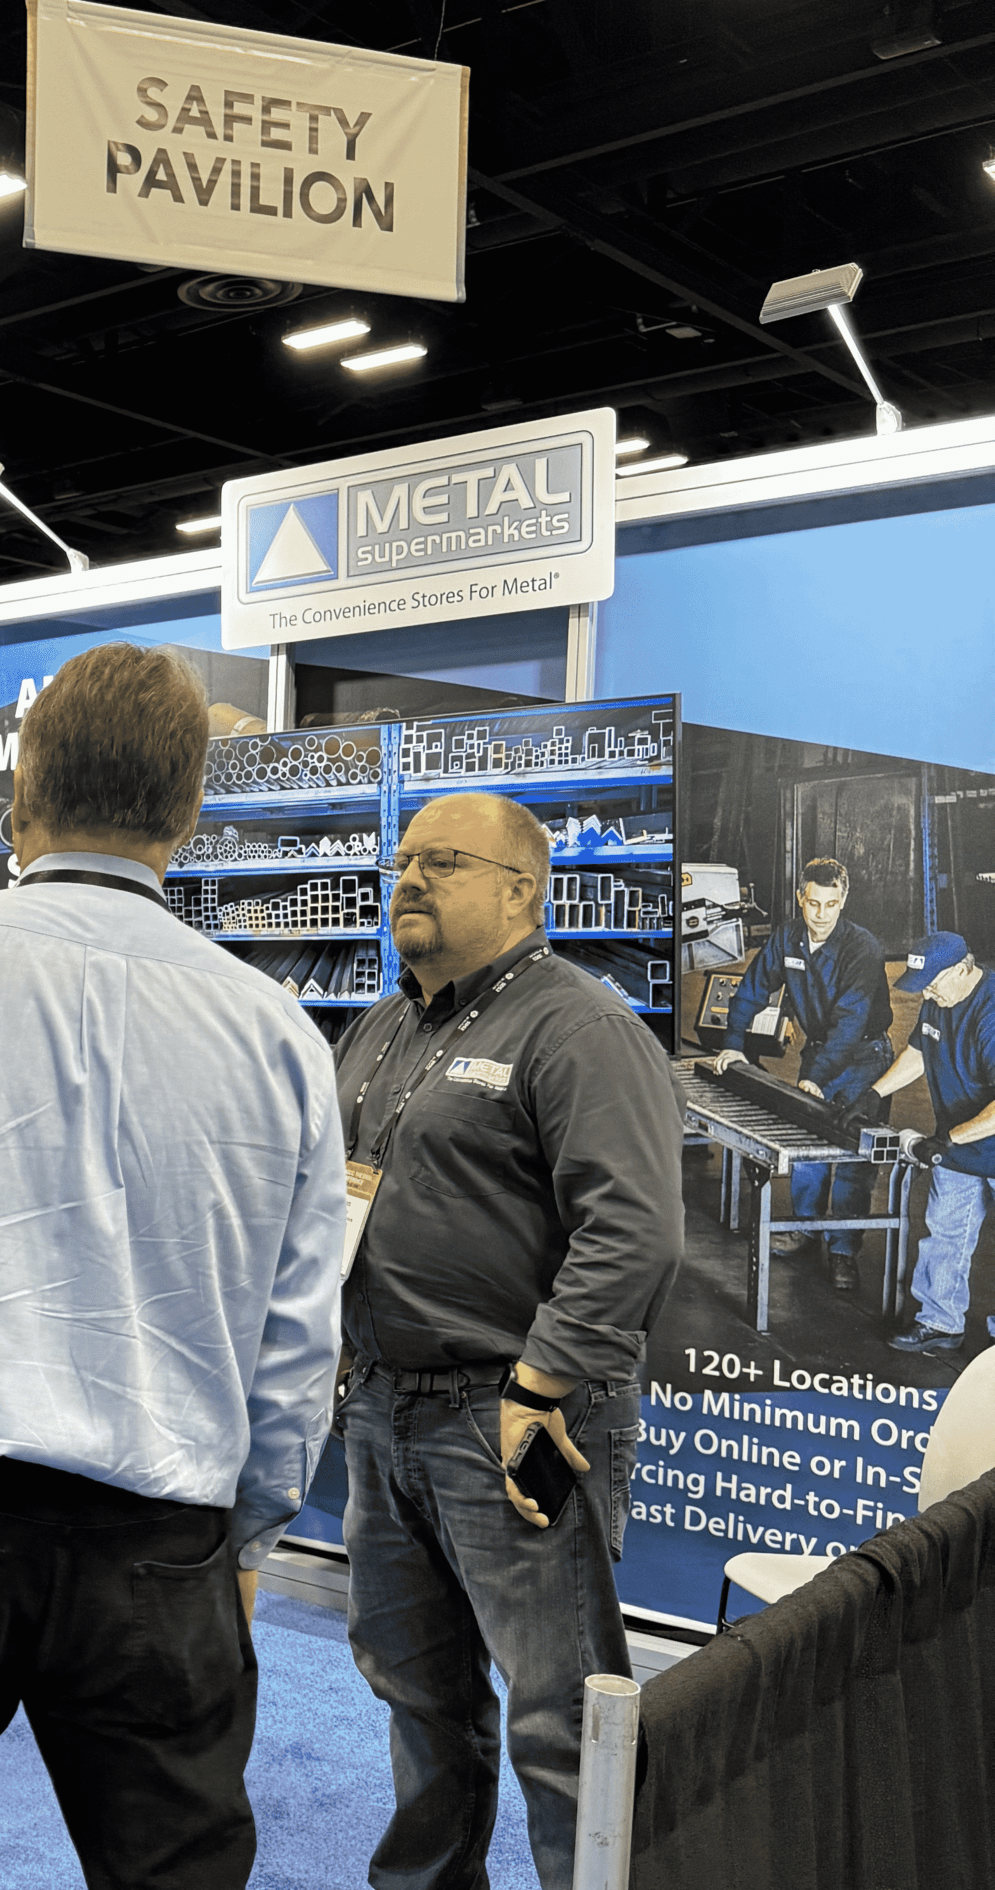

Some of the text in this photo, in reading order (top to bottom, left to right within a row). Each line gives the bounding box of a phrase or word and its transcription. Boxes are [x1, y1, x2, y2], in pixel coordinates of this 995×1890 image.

[135, 76, 372, 161] SAFETY
[106, 140, 395, 232] PAVILION
[356, 457, 571, 538] METAL
[356, 510, 570, 568] supermarkets
[269, 613, 298, 629] The
[302, 597, 406, 624] Convenience
[411, 591, 464, 609] Stores
[469, 582, 497, 601] For
[471, 1061, 509, 1077] METAL
[684, 1348, 939, 1412] 120+ Locations
[650, 1381, 693, 1411] No
[702, 1389, 861, 1441] Minimum
[630, 1460, 705, 1499] rcing
[636, 1417, 921, 1494] Buy Online or In-S
[631, 1500, 676, 1527] ast
[684, 1505, 818, 1556] Delivery
